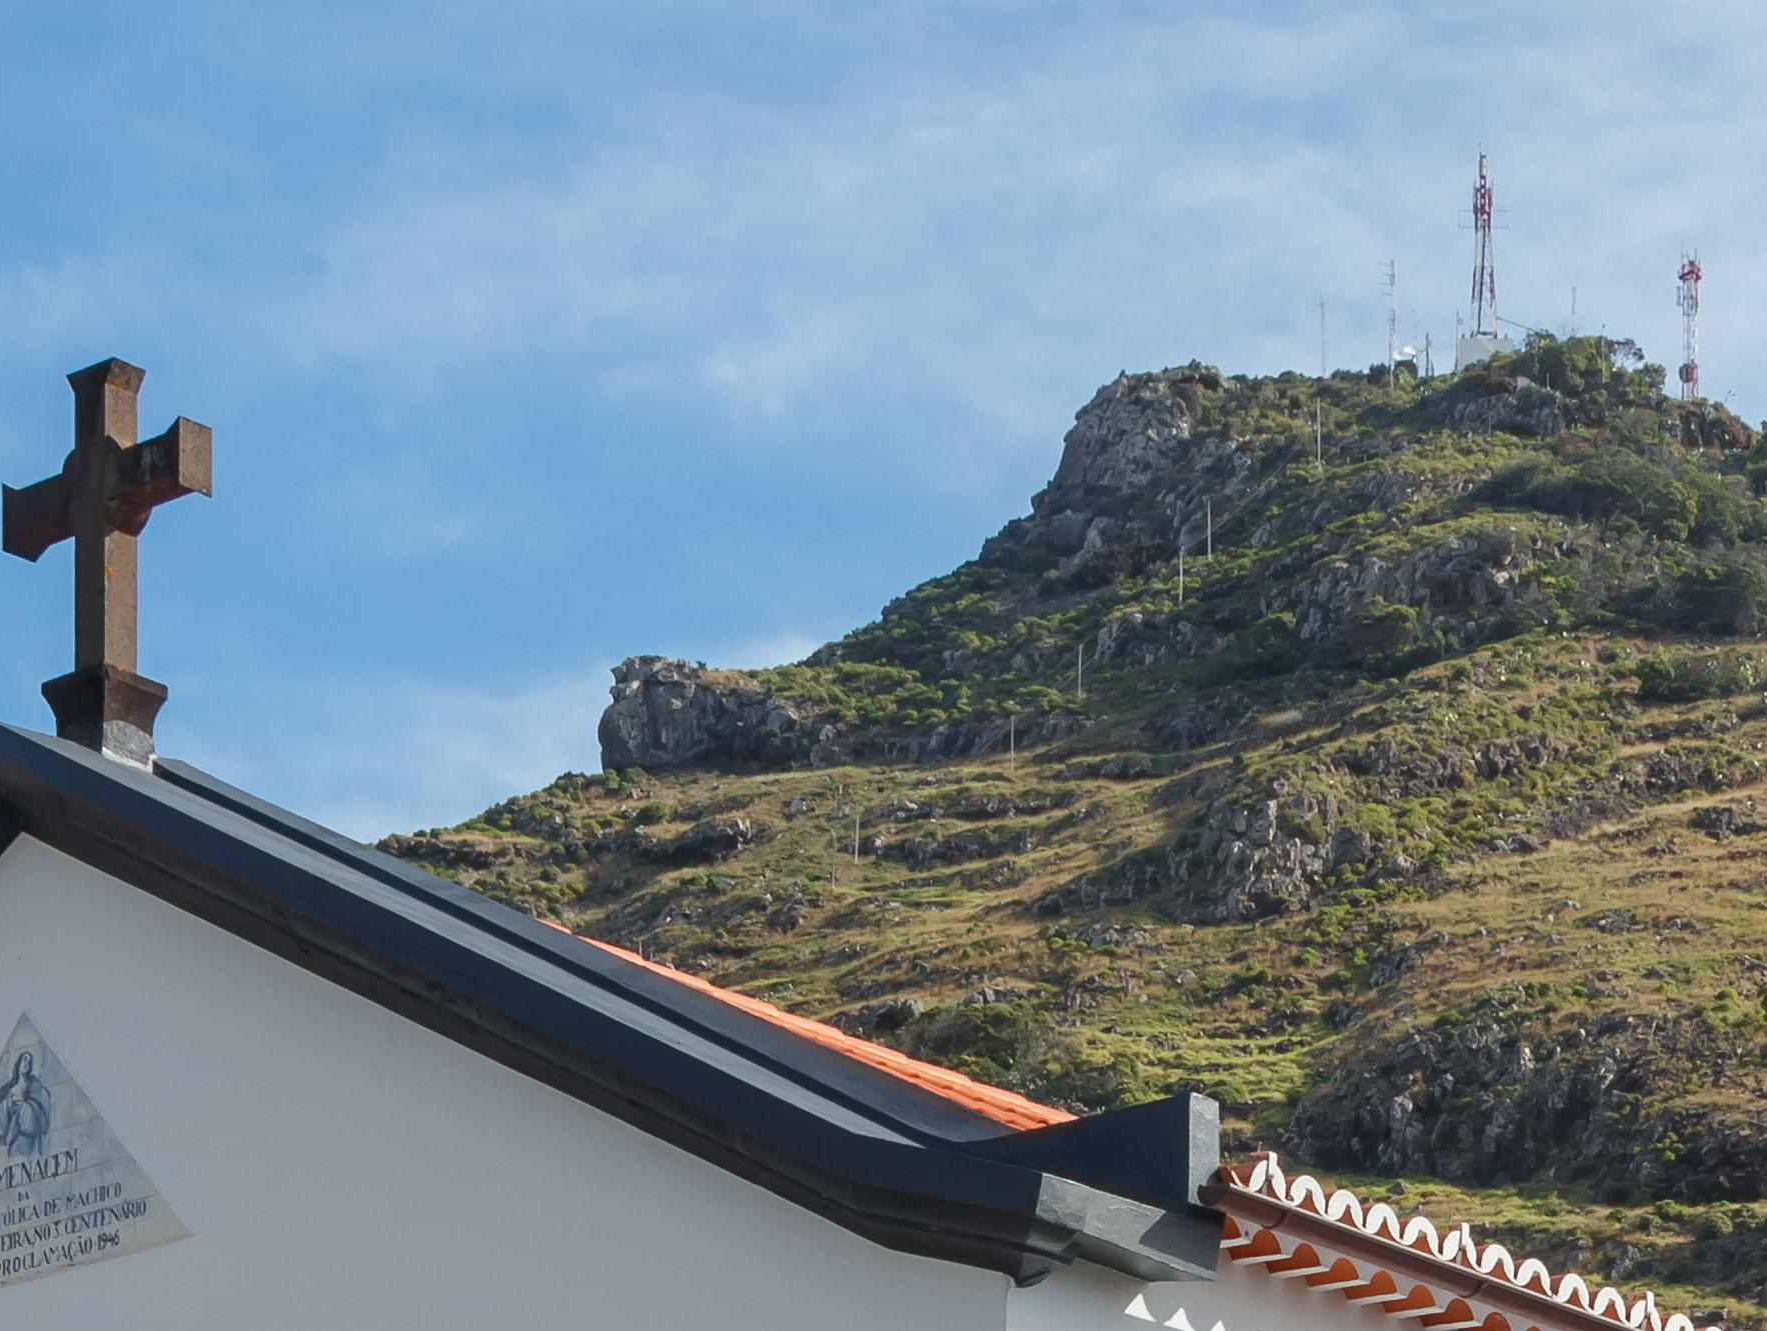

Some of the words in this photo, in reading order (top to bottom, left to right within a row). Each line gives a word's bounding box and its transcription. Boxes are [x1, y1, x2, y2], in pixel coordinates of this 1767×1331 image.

[18, 1191, 30, 1202] DA
[44, 1198, 61, 1217] DE
[65, 1182, 122, 1210] MACHICO
[65, 1198, 147, 1234] CENTENÁRIO
